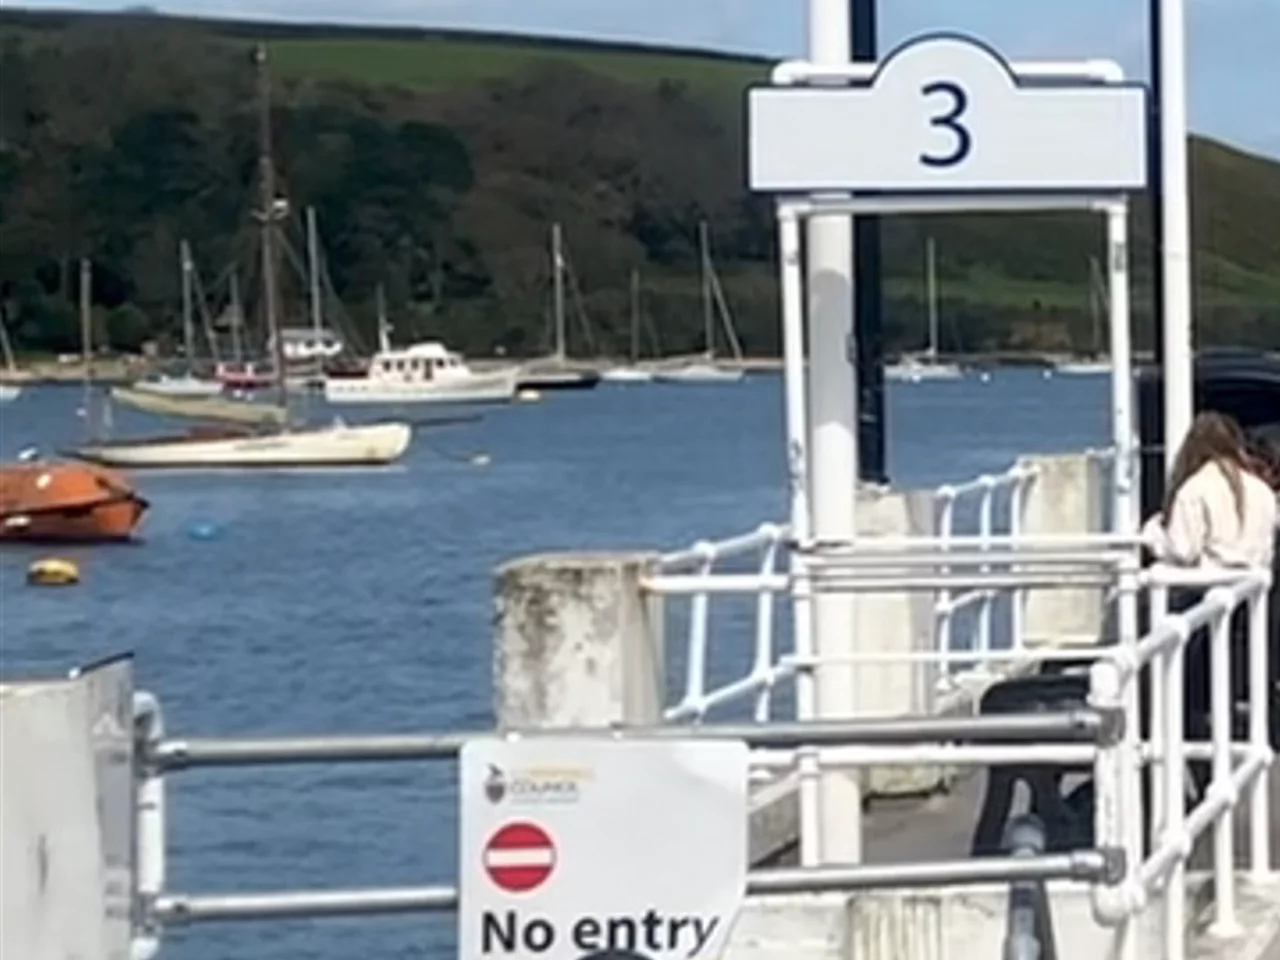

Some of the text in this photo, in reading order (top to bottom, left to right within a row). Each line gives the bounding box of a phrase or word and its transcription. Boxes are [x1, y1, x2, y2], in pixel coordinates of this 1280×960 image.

[920, 81, 971, 167] 3
[481, 909, 720, 958] No entry
